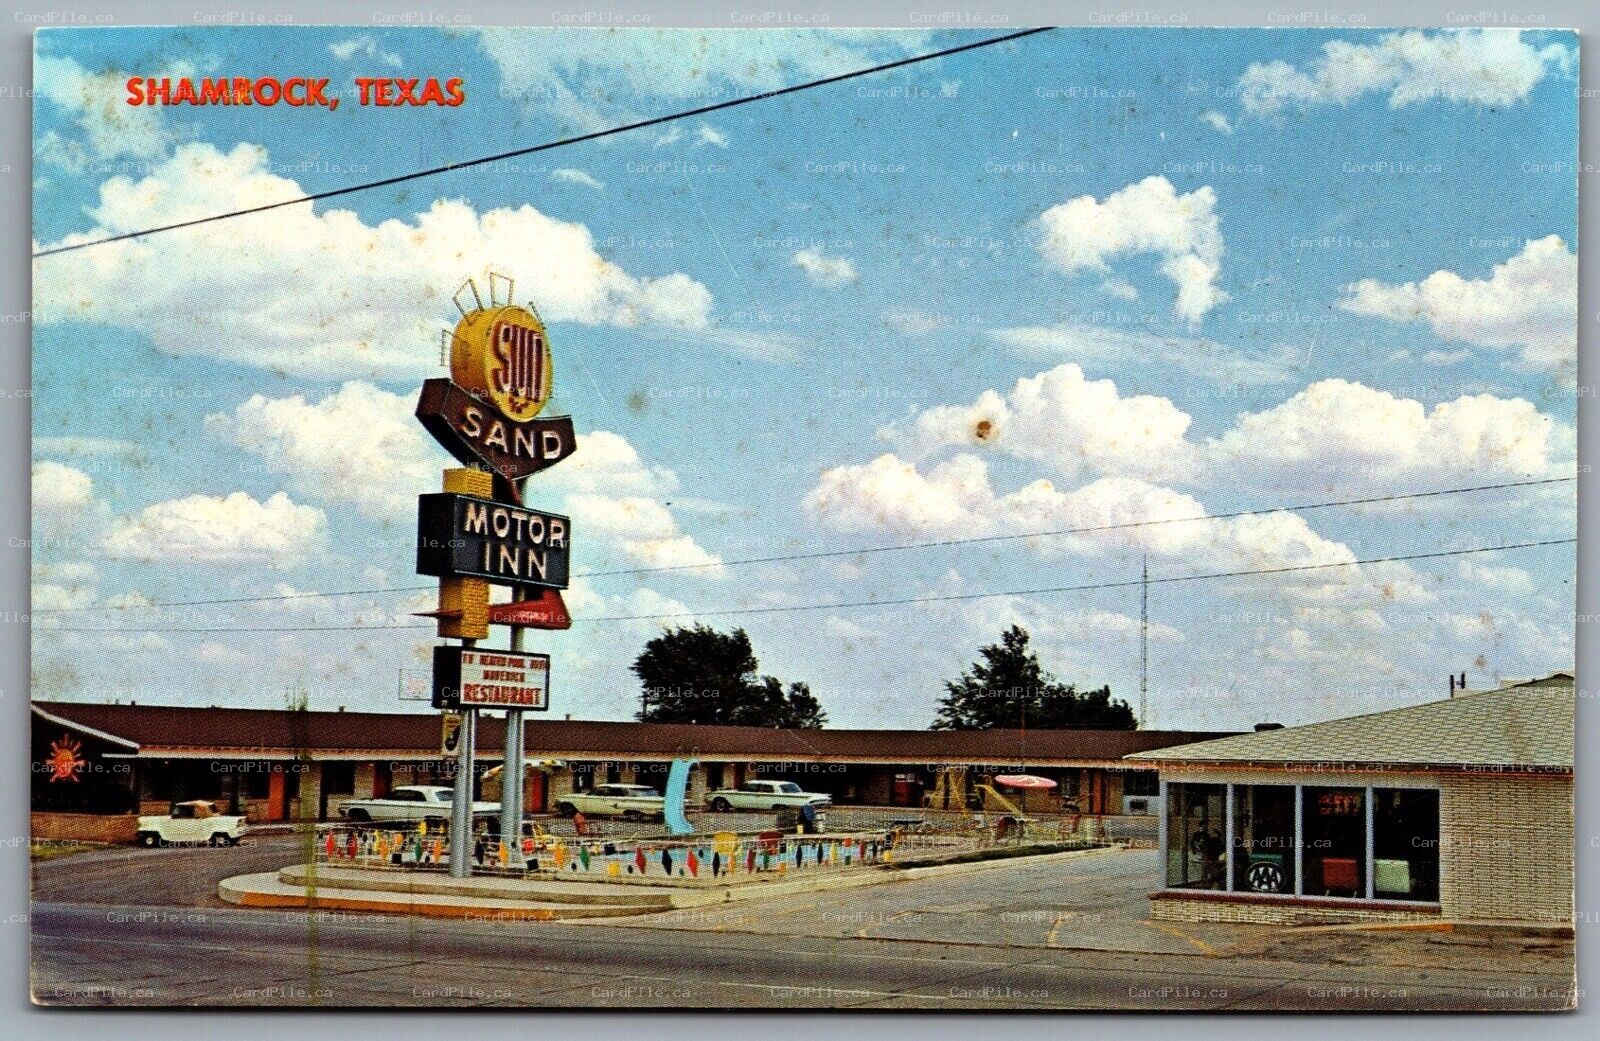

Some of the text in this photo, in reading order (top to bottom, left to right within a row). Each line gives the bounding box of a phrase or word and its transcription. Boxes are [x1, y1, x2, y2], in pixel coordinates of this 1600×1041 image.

[463, 406, 562, 460] SAND
[464, 502, 565, 548] MOTOR
[484, 543, 547, 580] INN
[463, 683, 542, 705] RESTAURANT
[1250, 865, 1281, 890] AAA
